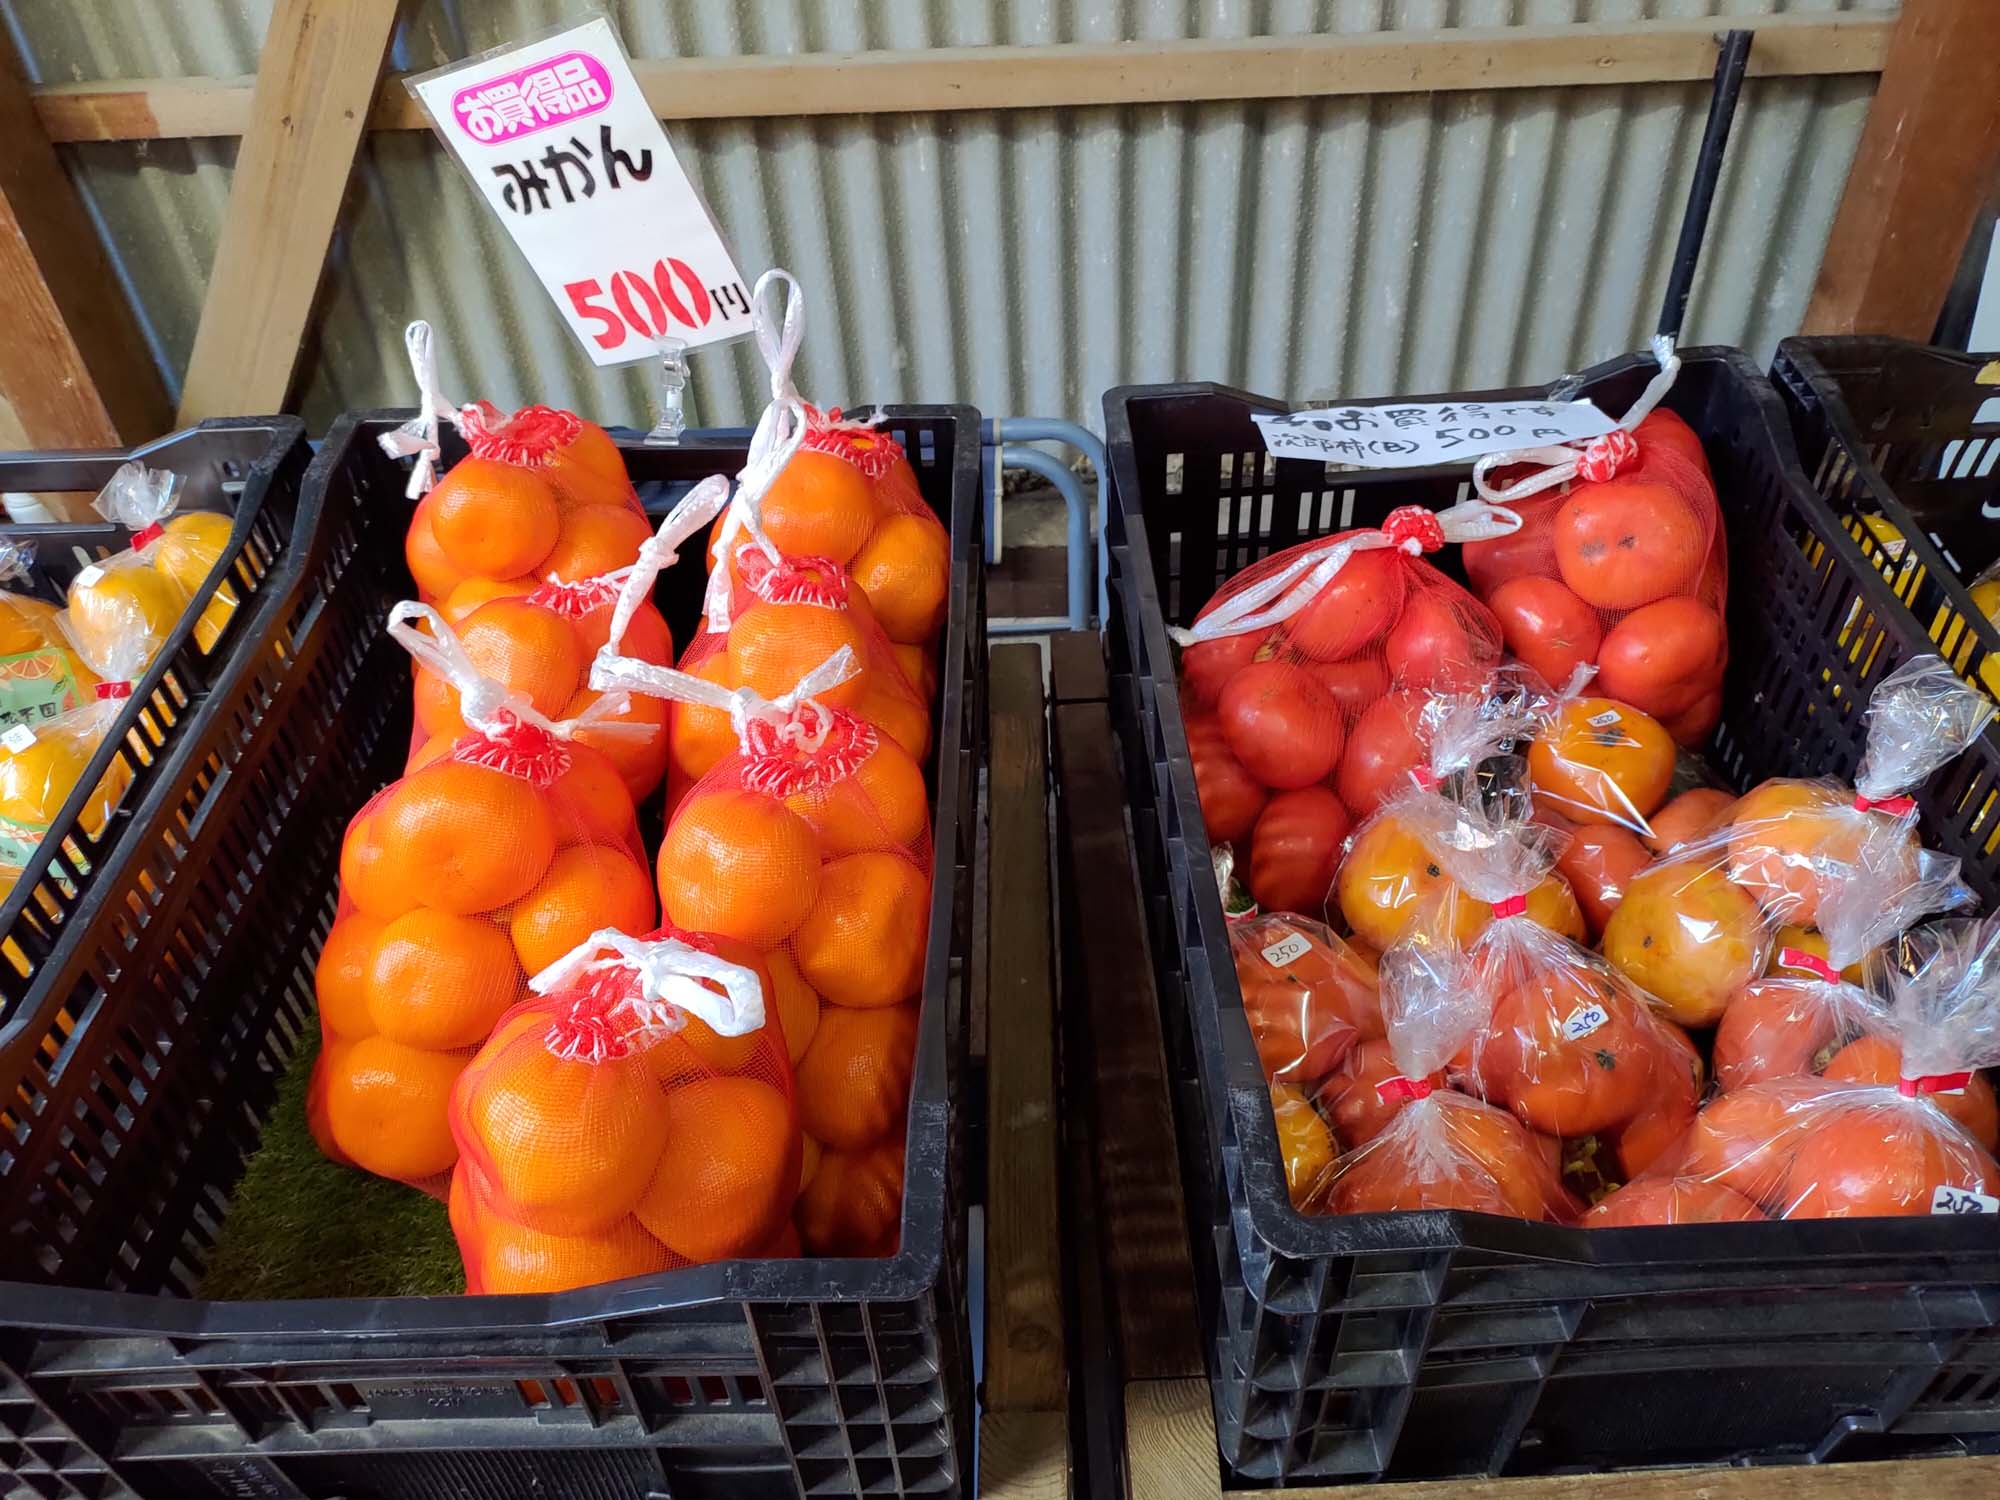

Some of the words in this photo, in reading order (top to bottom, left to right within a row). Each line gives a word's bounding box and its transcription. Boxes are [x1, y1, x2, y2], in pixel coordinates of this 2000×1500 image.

[456, 58, 606, 140] お買得品
[491, 125, 653, 215] みかん
[1270, 943, 1299, 962] 250
[1571, 1011, 1600, 1033] 250
